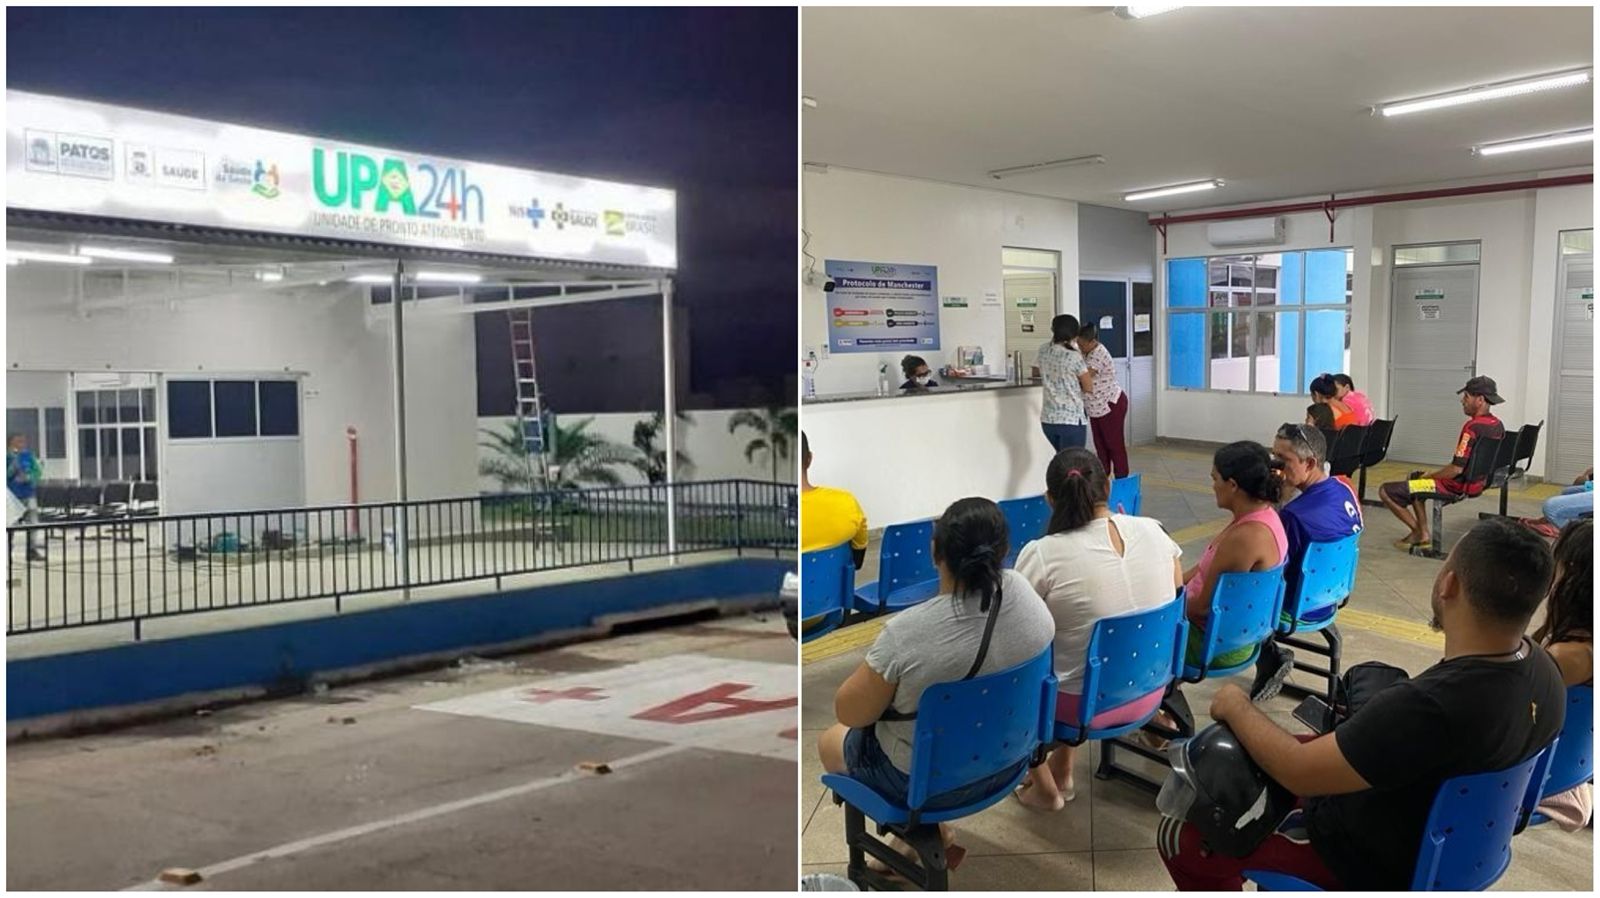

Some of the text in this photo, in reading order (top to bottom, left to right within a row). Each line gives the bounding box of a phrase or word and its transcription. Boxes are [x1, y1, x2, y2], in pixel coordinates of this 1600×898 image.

[60, 142, 110, 161] PATOS
[314, 211, 360, 231] UNIDADE
[363, 217, 379, 232] DE
[380, 218, 418, 236] PRONTO
[842, 278, 876, 289] Protocolo
[887, 281, 925, 290] Manchester
